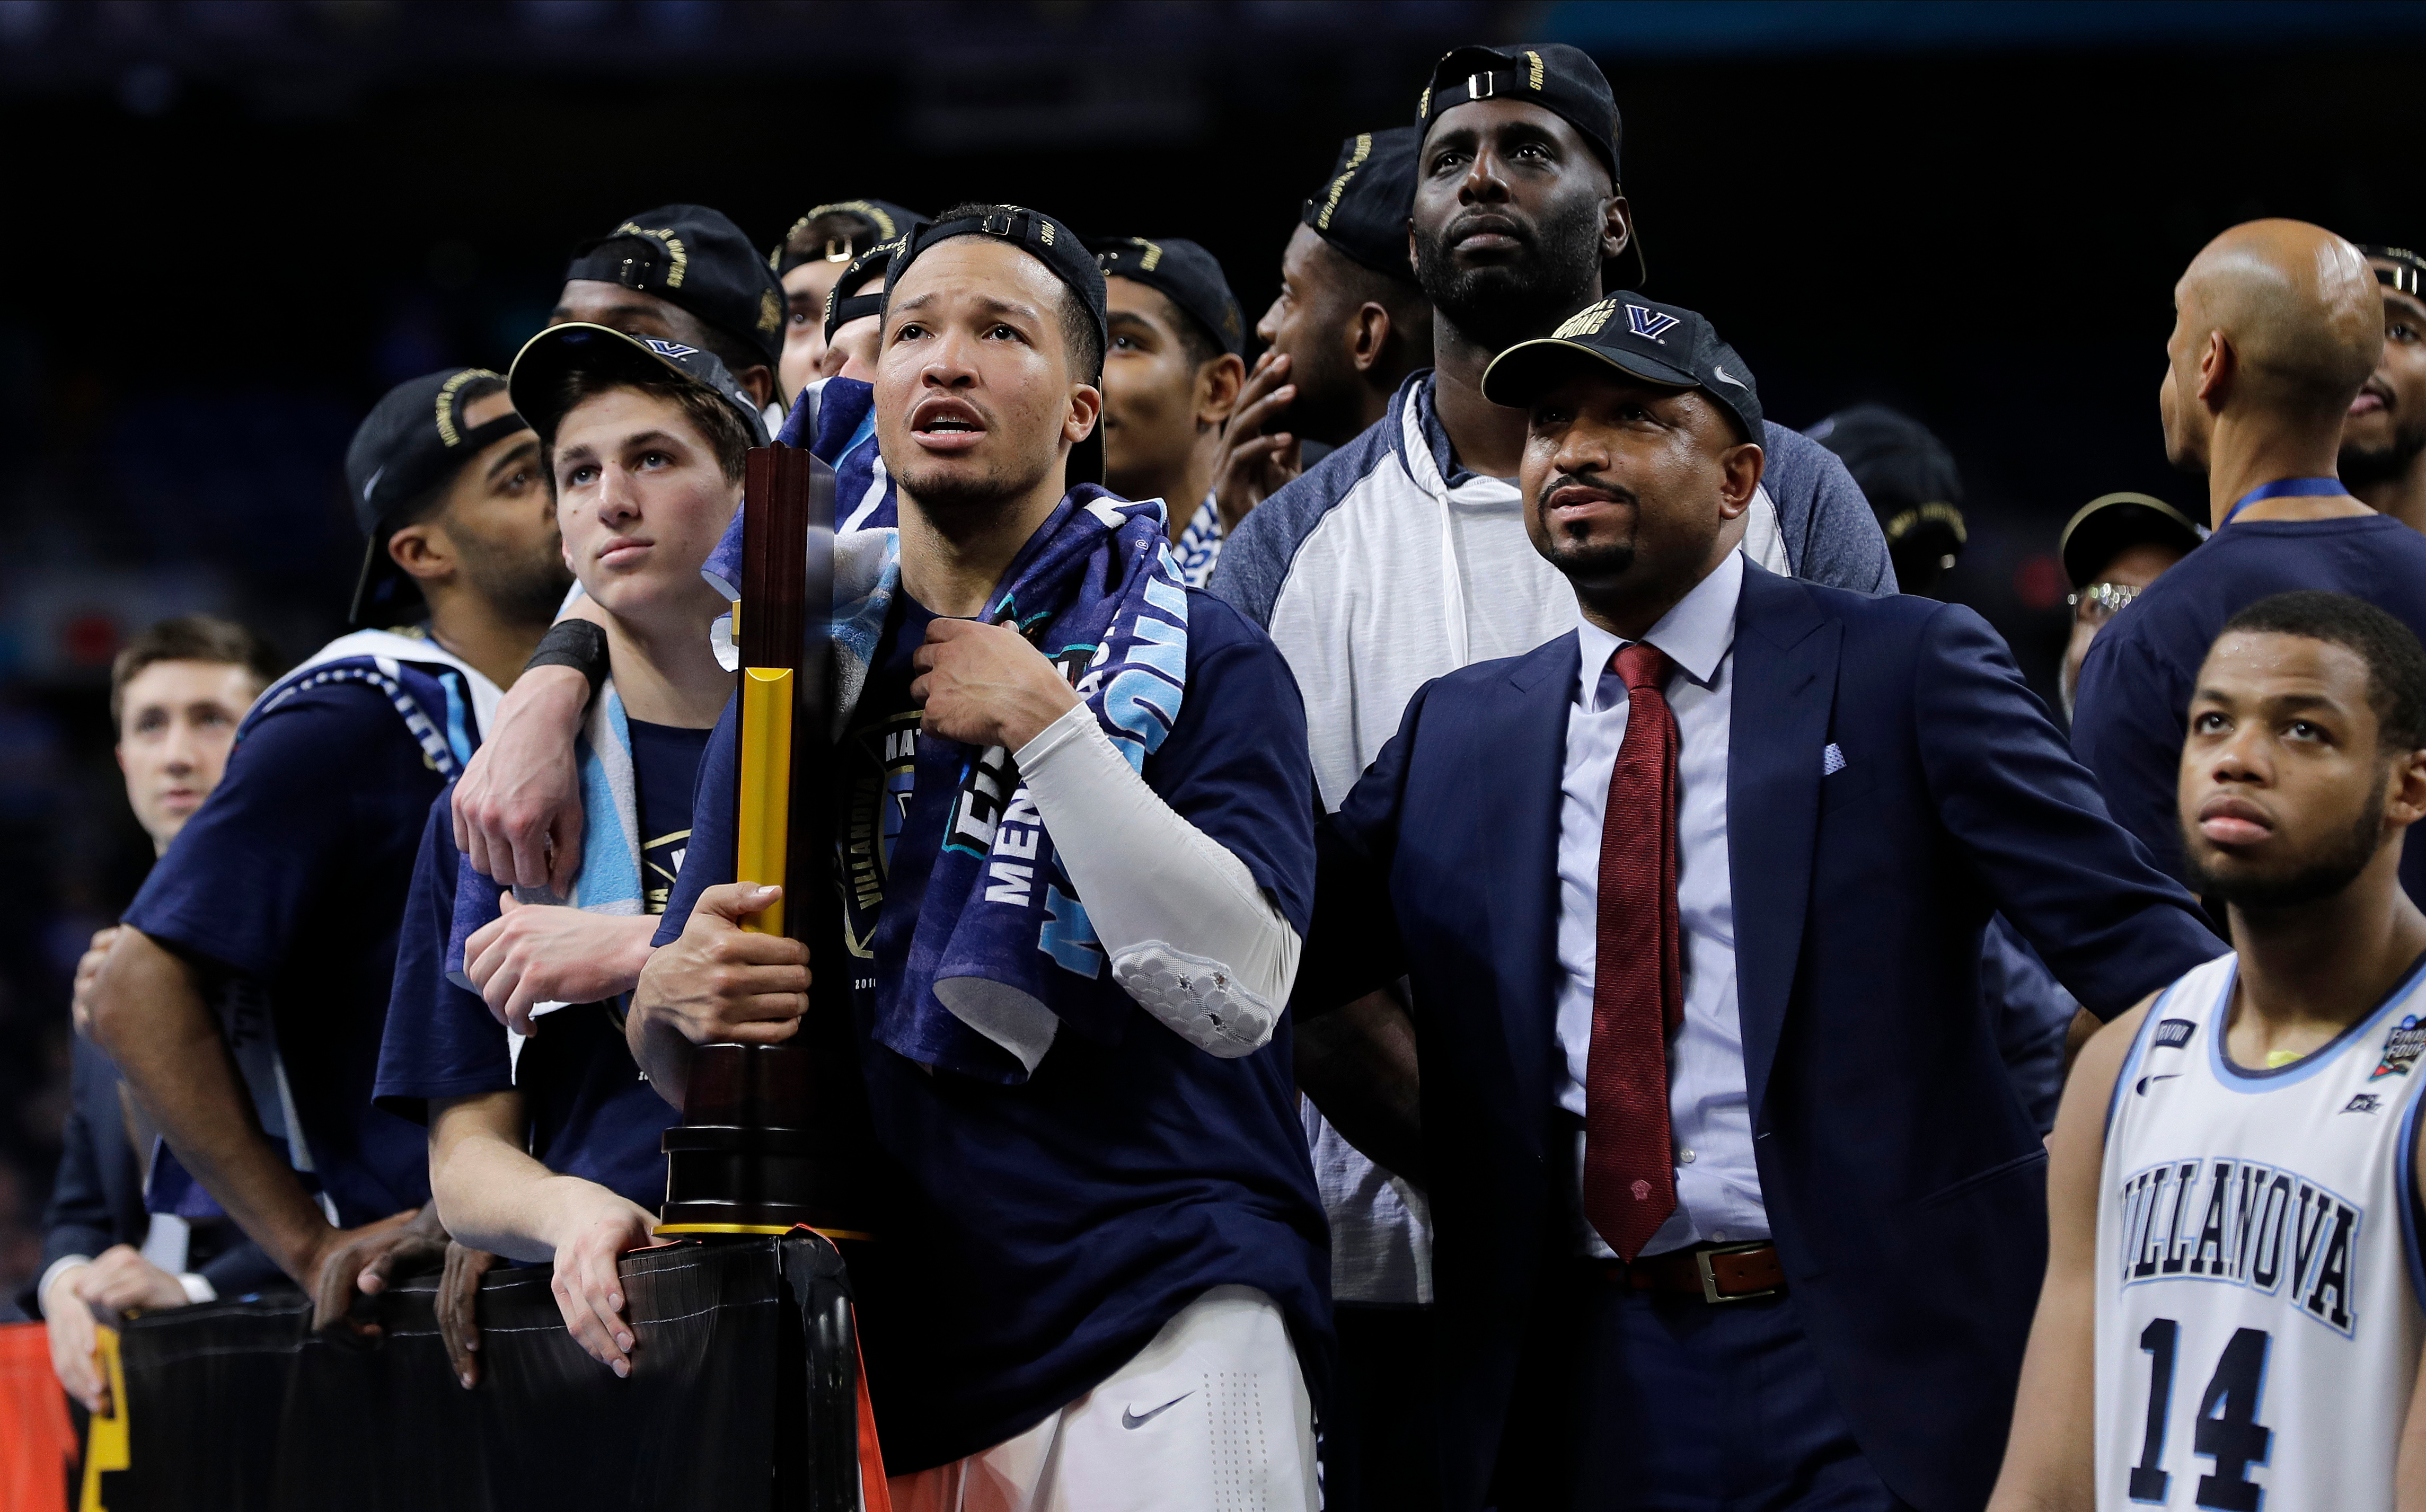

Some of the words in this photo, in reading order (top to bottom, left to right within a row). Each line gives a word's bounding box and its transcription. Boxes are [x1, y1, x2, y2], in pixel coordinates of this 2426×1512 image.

[1624, 304, 1680, 339] V
[851, 777, 883, 910] VILLANOVA
[2129, 1318, 2275, 1512] 14
